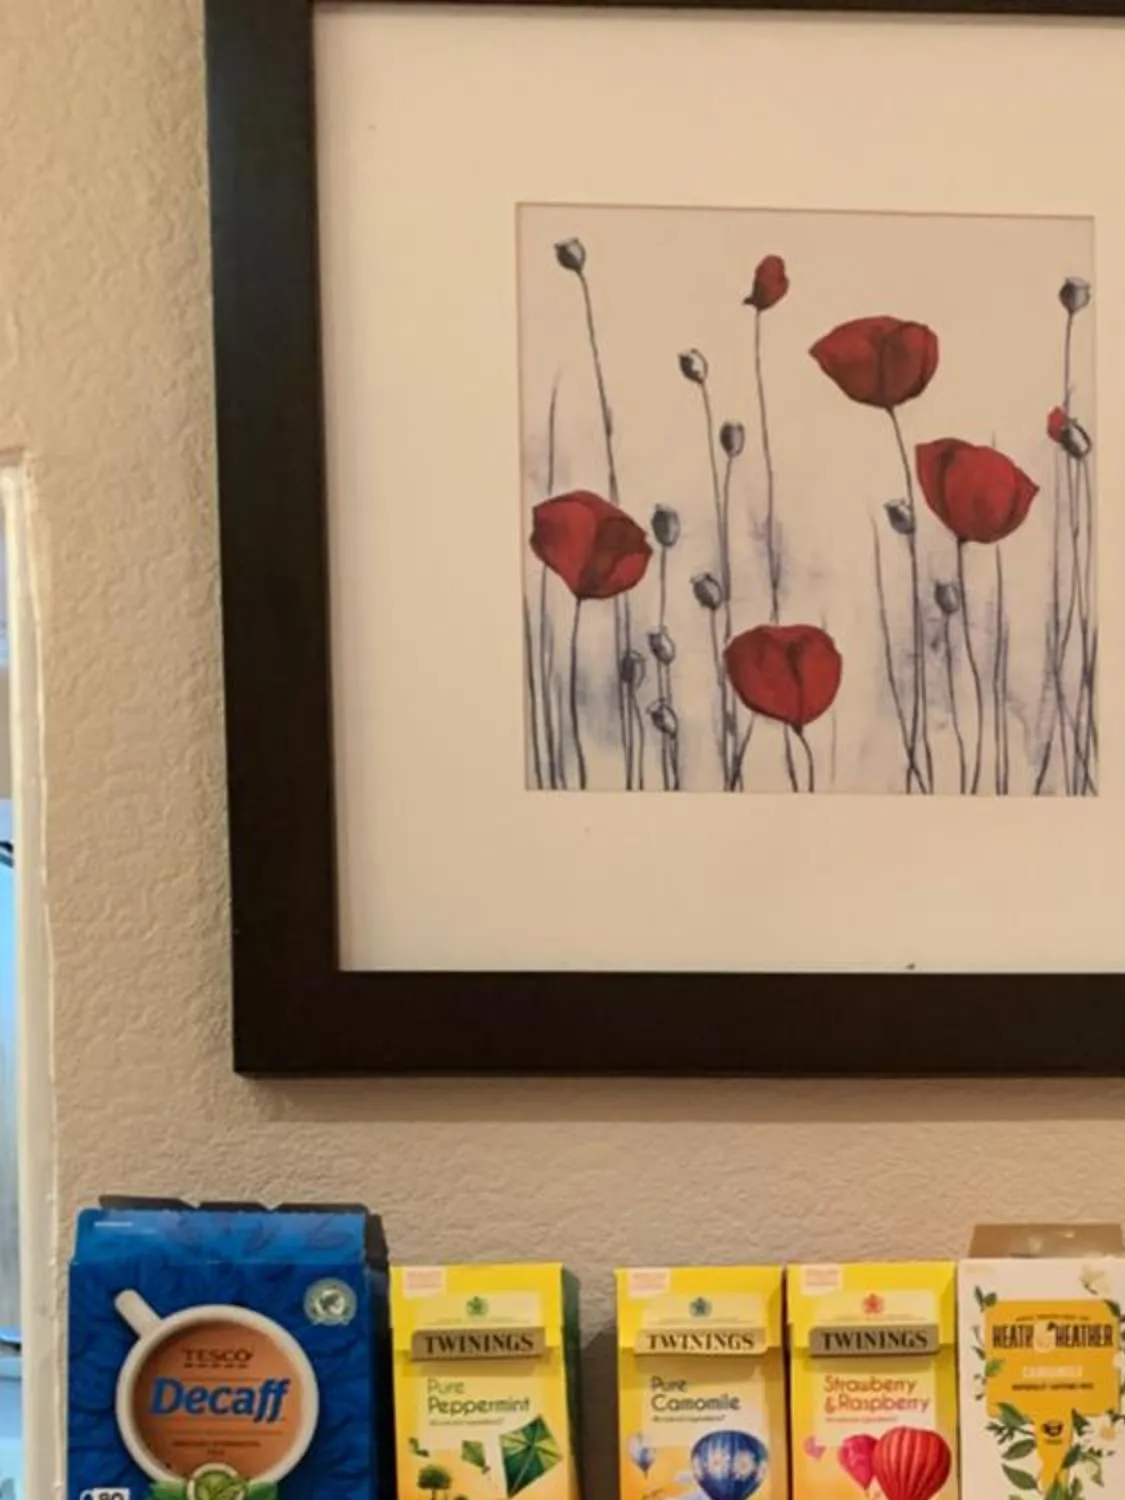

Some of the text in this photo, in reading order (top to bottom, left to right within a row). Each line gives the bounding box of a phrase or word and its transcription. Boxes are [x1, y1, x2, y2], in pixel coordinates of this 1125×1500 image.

[424, 1333, 534, 1354] TWININGS
[646, 1331, 755, 1350] TWININGS
[821, 1330, 929, 1350] TWININGS
[183, 1349, 253, 1363] TESCO
[427, 1377, 465, 1394] Pure
[651, 1376, 688, 1392] Pure
[824, 1374, 917, 1394] Strawberry
[149, 1375, 291, 1424] Decaff
[427, 1395, 531, 1416] Peppermint
[652, 1392, 741, 1412] Camomile
